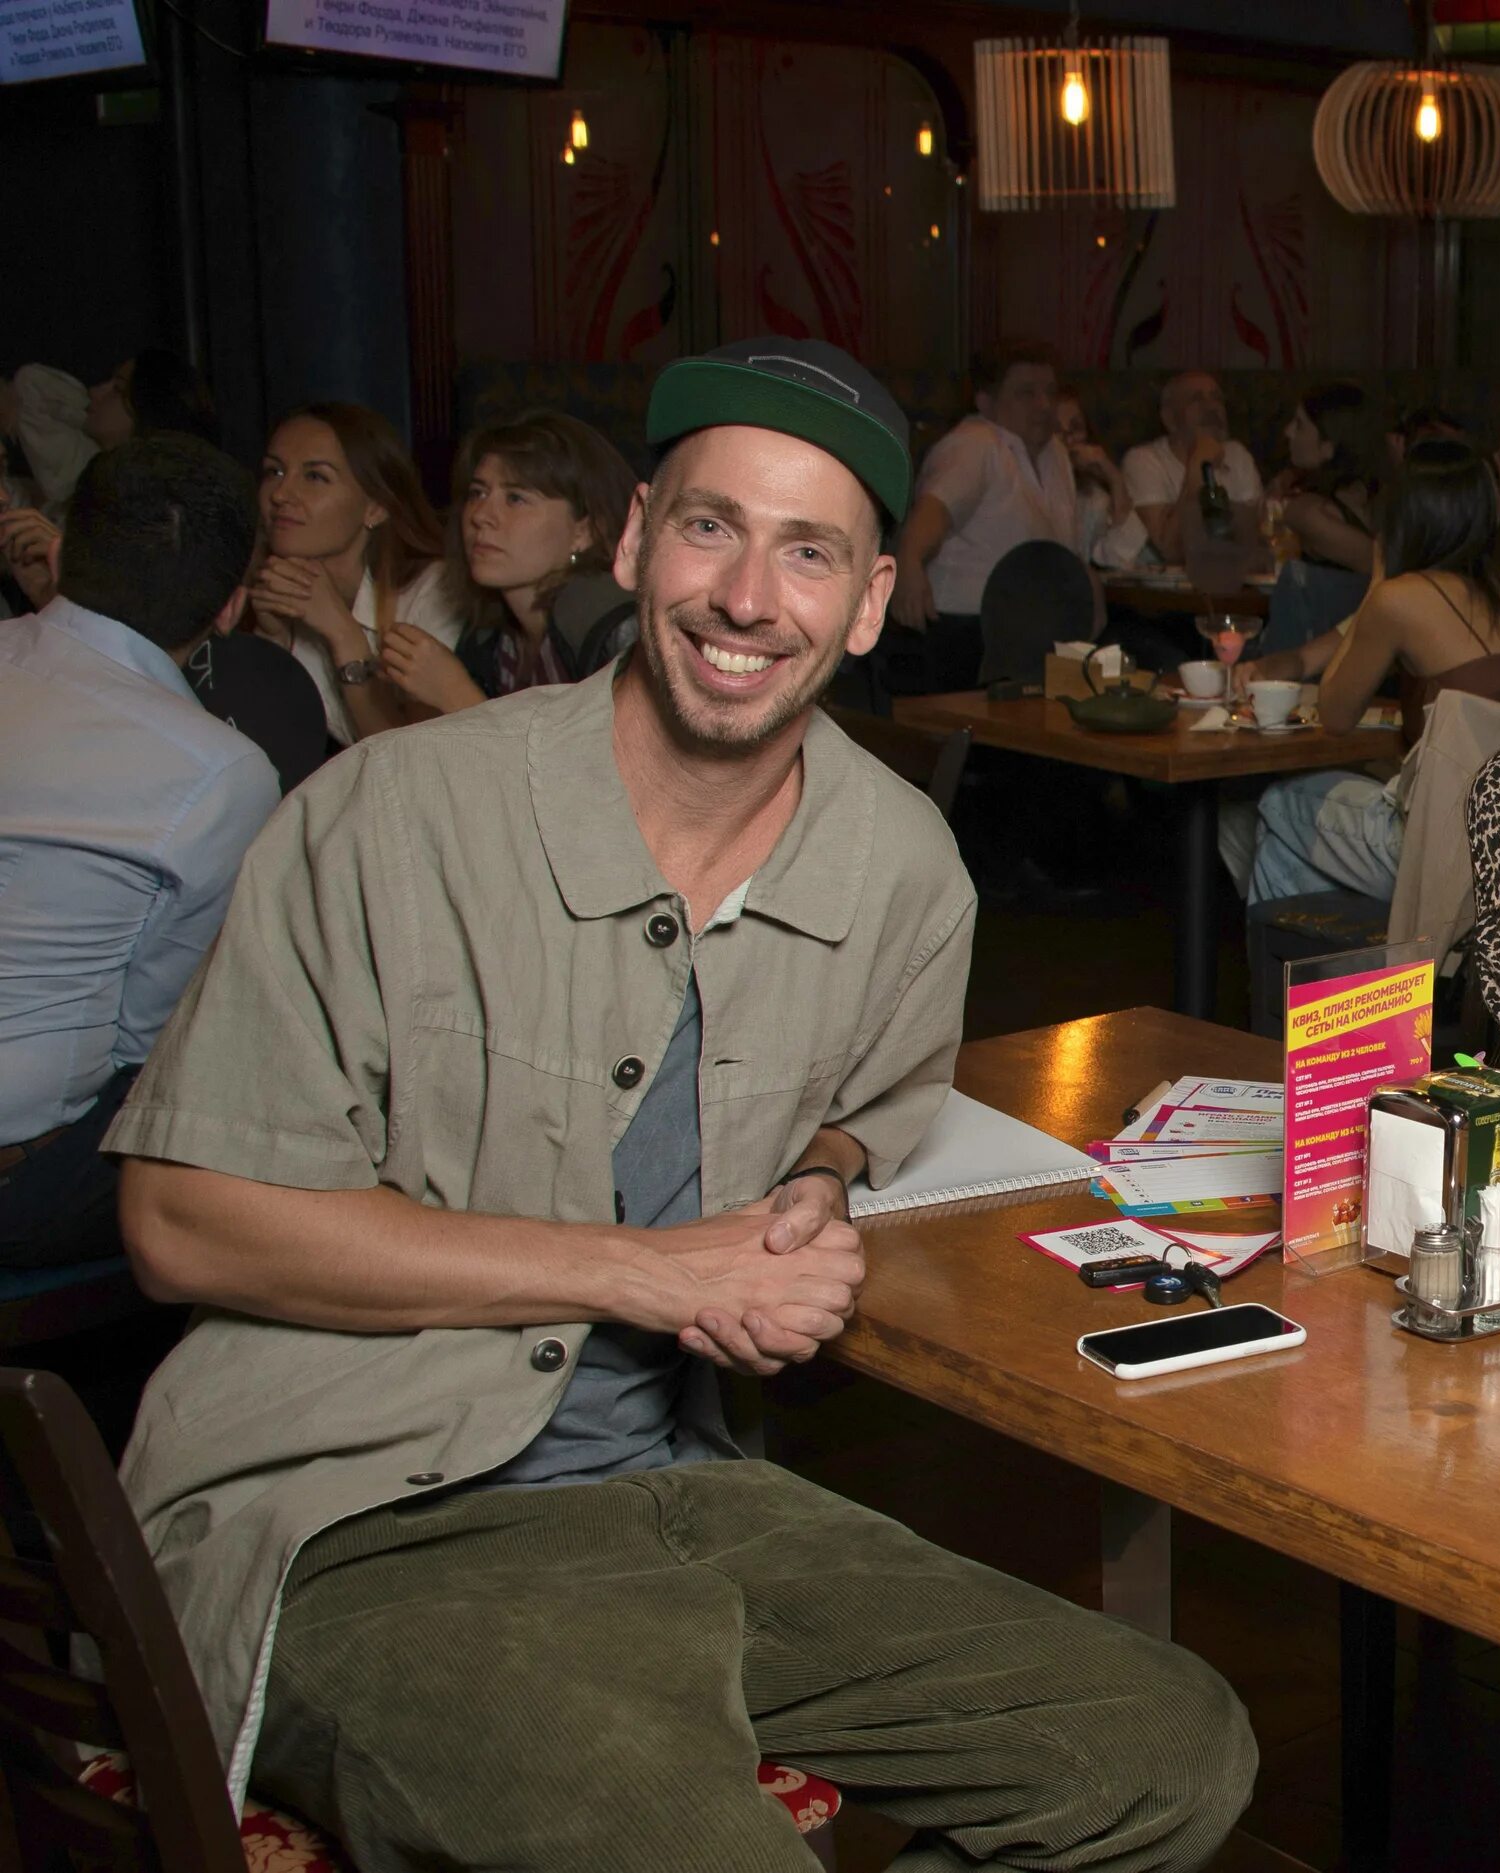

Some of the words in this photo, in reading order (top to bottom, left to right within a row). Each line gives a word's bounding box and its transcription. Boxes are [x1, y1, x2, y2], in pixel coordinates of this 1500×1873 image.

[317, 17, 372, 39] Теодора
[1292, 1009, 1321, 1029] КВИЗ,
[1323, 998, 1353, 1018] ПЛИЗ!
[1354, 973, 1426, 1008] РЕКОМЕНДУЕТ
[1306, 1019, 1335, 1038] СЕТЫ
[1335, 1014, 1350, 1028] НА
[1351, 992, 1413, 1023] КОМПАНИЮ
[1295, 1059, 1305, 1069] НА
[1306, 1051, 1341, 1067] КОМАНДУ
[1341, 1048, 1350, 1059] ИЗ
[1356, 1042, 1386, 1056] ЧЕЛОВЕК
[1294, 1139, 1305, 1149] НА
[1306, 1130, 1340, 1145] КОМАНДУ
[1340, 1127, 1350, 1137] ИЗ
